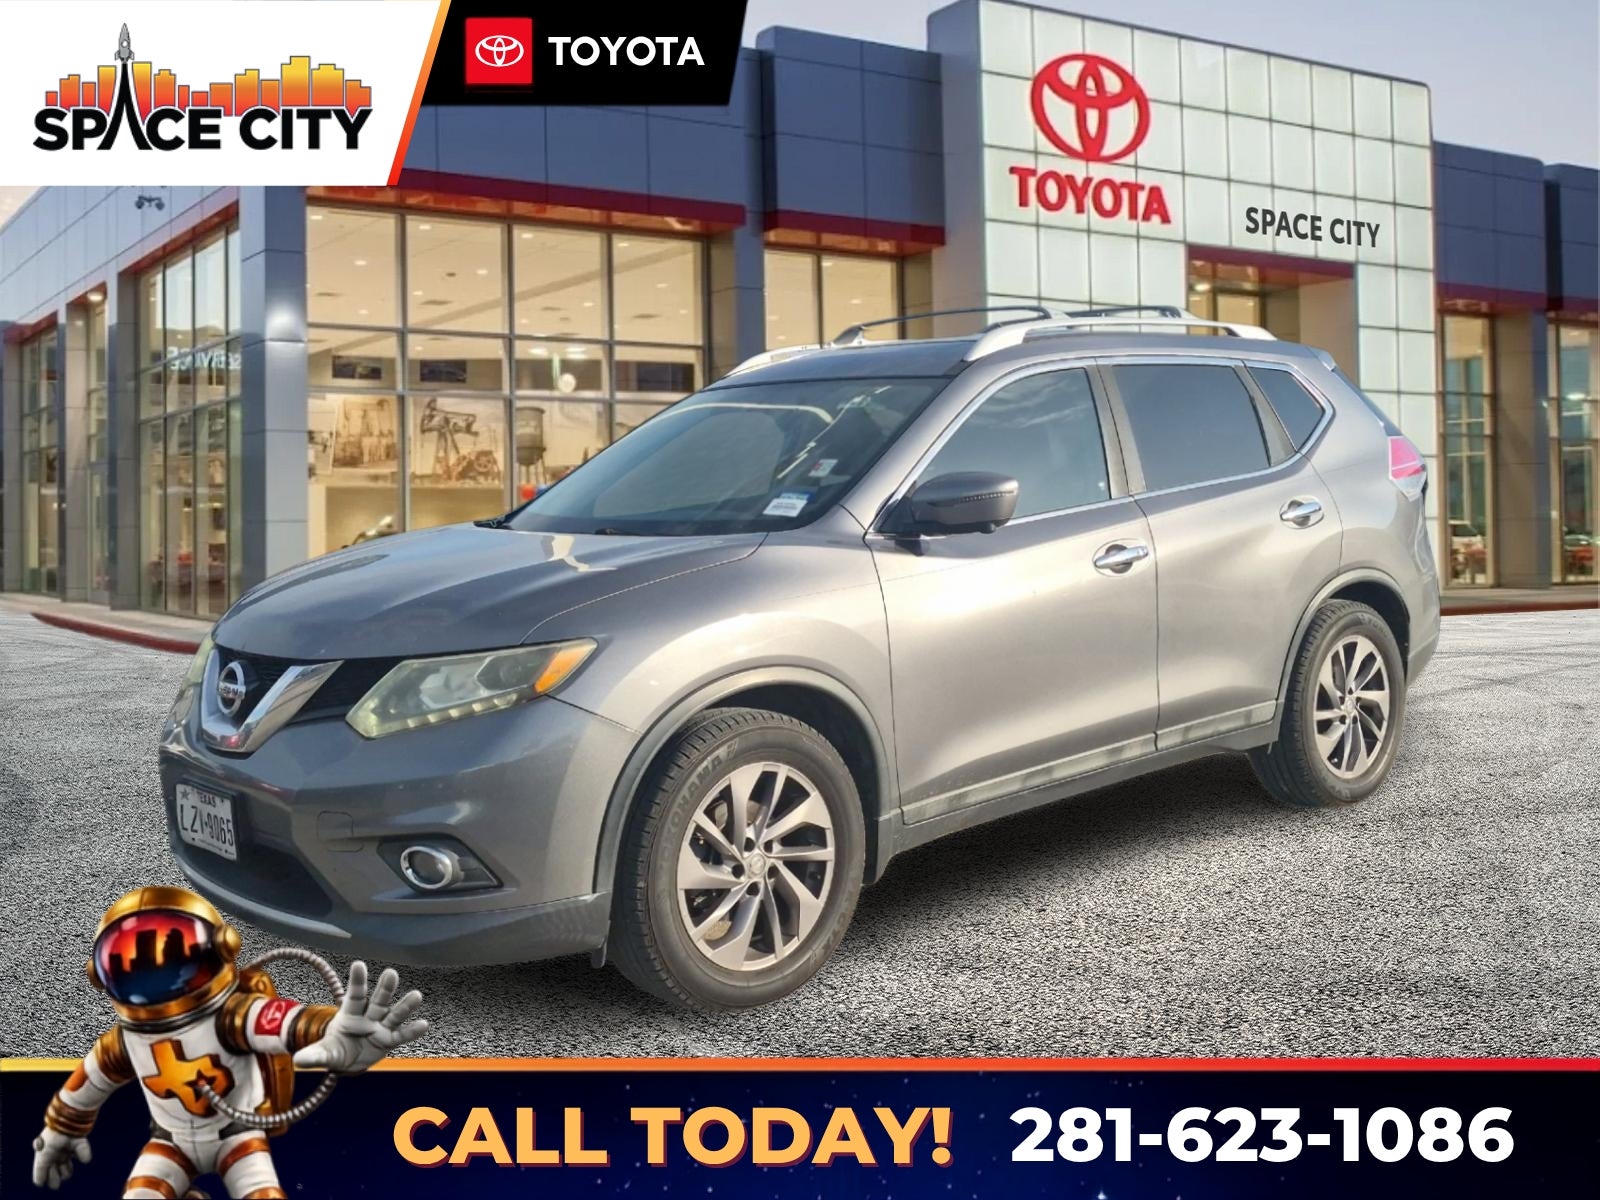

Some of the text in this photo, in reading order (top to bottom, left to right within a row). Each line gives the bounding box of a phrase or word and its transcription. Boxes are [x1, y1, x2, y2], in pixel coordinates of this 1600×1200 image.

[1009, 166, 1171, 224] TOYOTA
[1245, 206, 1381, 248] SPACE CITY
